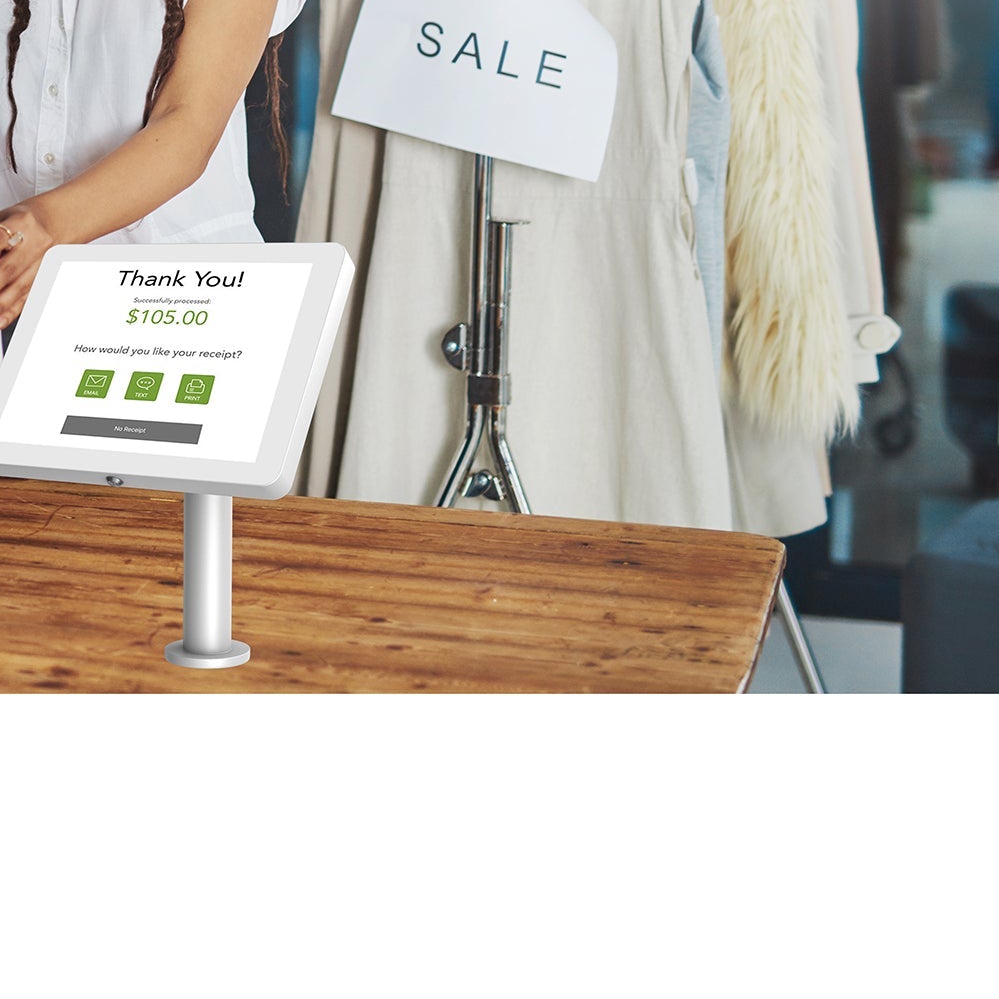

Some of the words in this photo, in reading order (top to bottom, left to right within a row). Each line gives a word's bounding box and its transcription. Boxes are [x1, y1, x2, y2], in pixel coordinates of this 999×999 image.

[417, 22, 566, 89] SALE
[119, 270, 187, 287] Thank
[195, 271, 245, 288] You!
[133, 297, 173, 305] Successfully
[173, 297, 212, 305] processed:
[126, 308, 208, 326] $105.00
[74, 344, 98, 353] How
[98, 346, 129, 355] would
[130, 349, 150, 357] you
[152, 347, 171, 357] like
[173, 351, 197, 359] your
[199, 350, 243, 360] receipt?
[123, 425, 147, 434] Receipt
